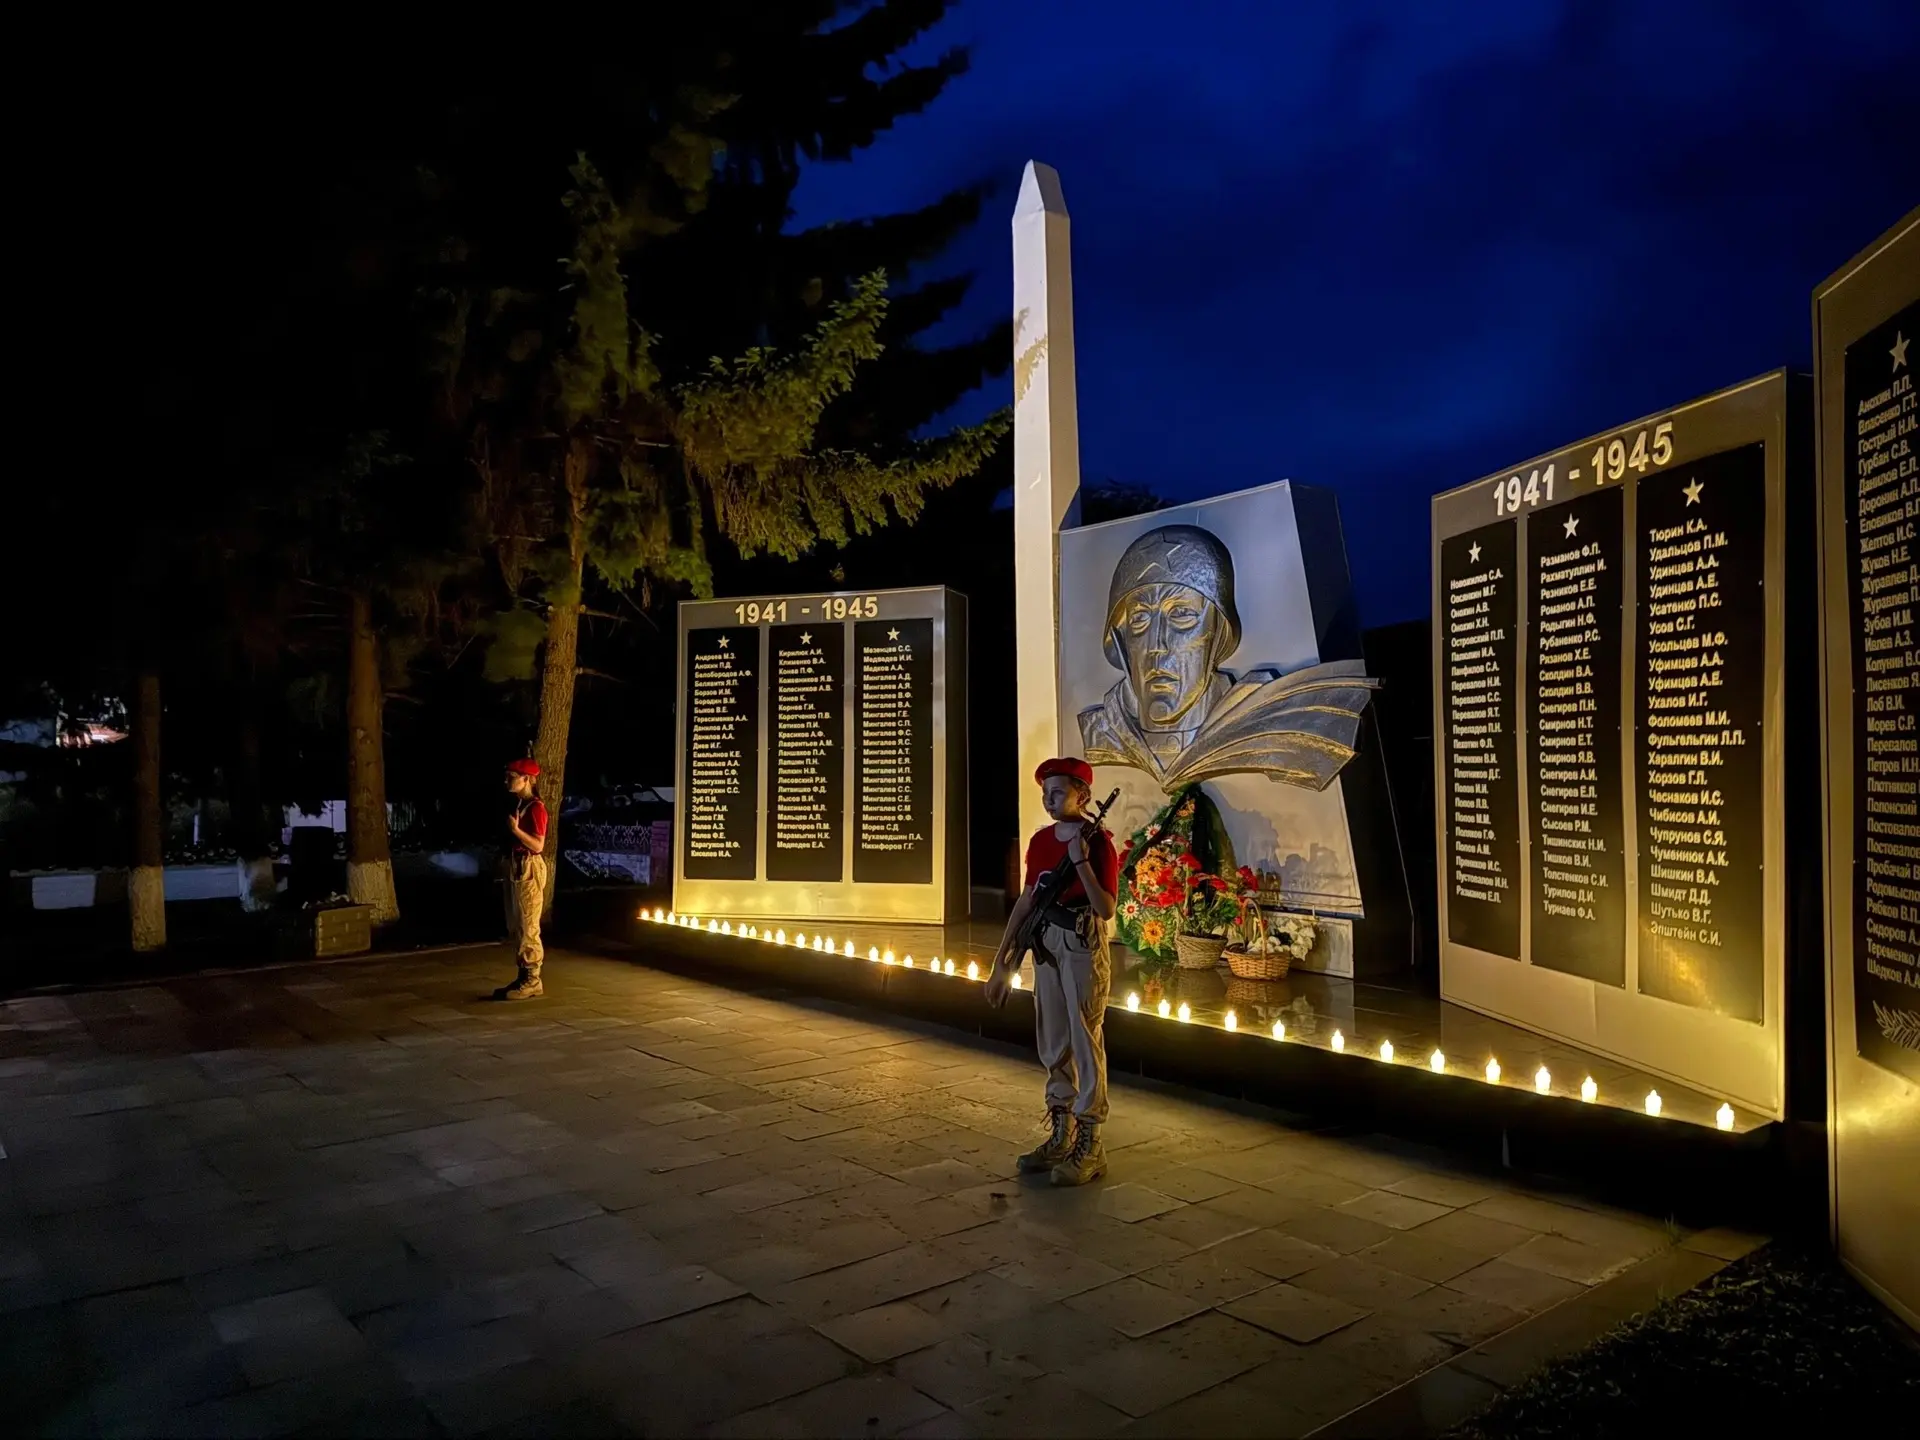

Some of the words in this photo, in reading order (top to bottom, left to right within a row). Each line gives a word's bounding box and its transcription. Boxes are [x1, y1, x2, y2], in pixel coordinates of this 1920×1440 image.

[1493, 464, 1555, 516] 1941
[1591, 421, 1673, 485] 1945
[735, 601, 787, 624] 1941
[822, 596, 878, 620] 1945
